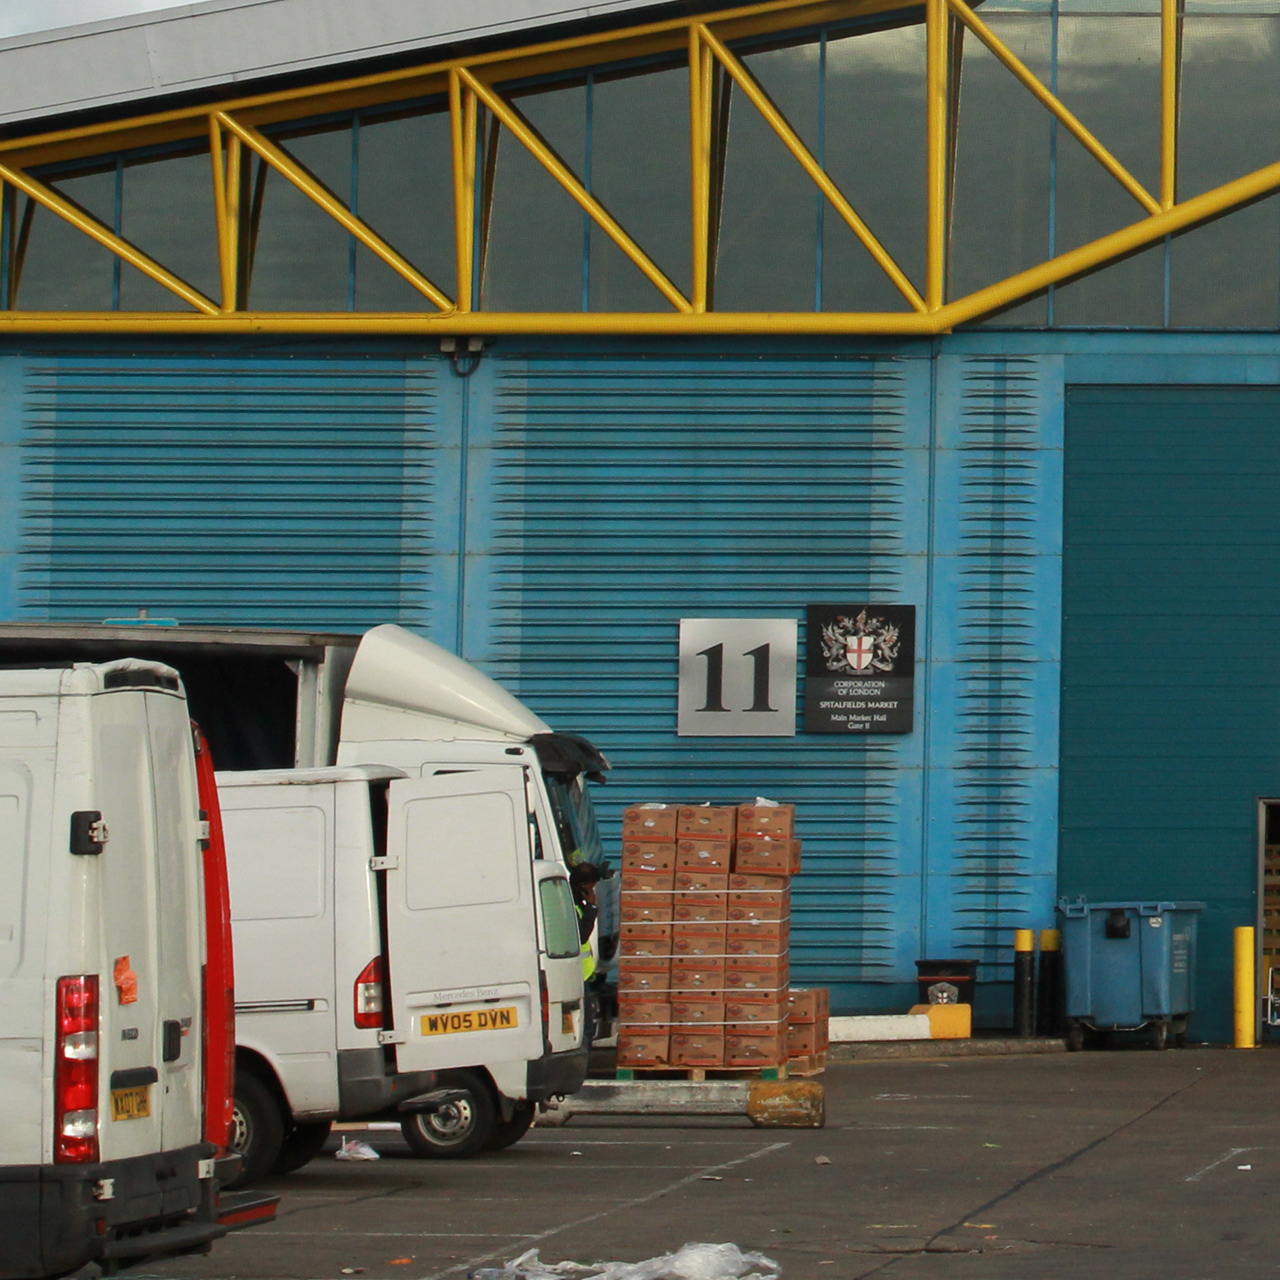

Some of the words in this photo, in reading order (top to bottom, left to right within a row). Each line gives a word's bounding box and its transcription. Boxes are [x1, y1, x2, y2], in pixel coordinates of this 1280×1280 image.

[695, 642, 779, 712] 11
[838, 688, 848, 696] OF
[849, 688, 881, 696] LONDON
[819, 701, 866, 709] SPITALFIELDS
[867, 701, 899, 709] MARKET
[847, 722, 864, 730] Gate
[433, 990, 474, 1002] Mercedes
[477, 987, 499, 997] Benz
